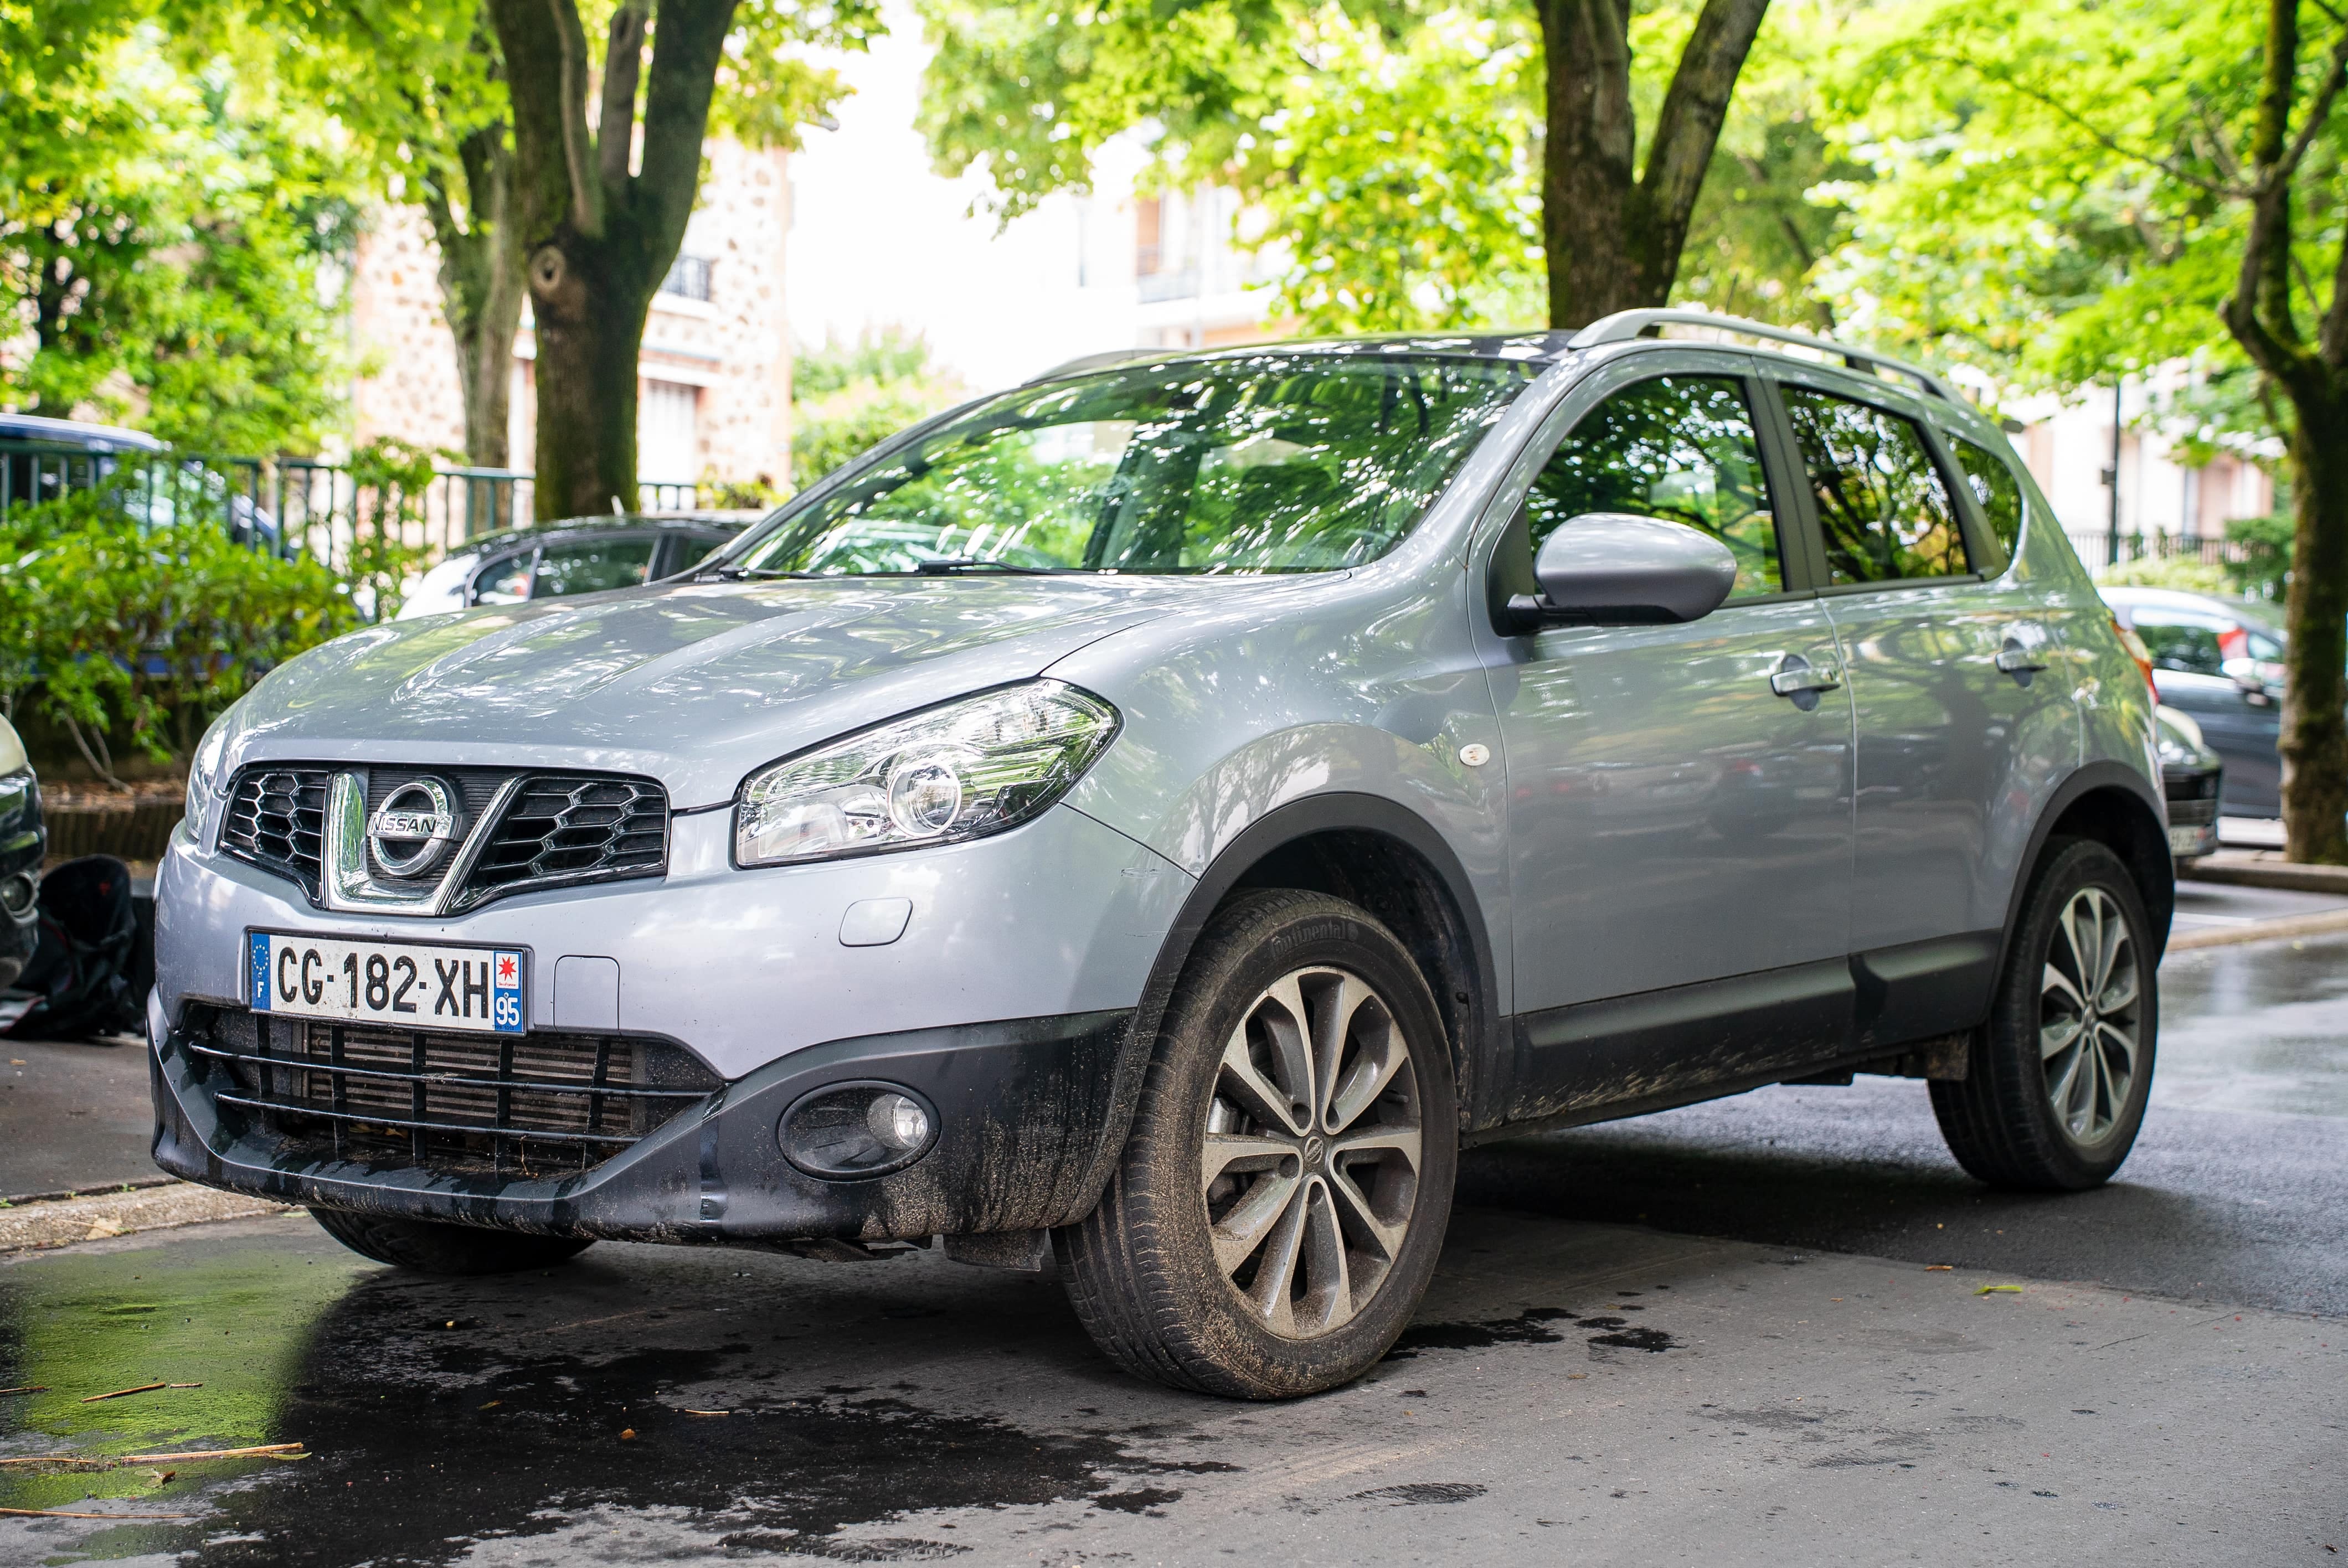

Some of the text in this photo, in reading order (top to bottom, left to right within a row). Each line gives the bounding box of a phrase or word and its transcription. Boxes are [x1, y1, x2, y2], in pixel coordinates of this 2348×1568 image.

[371, 817, 437, 833] NISSAN
[256, 981, 265, 999] F
[277, 946, 489, 1019] CG-182-XH
[496, 996, 520, 1026] 95
